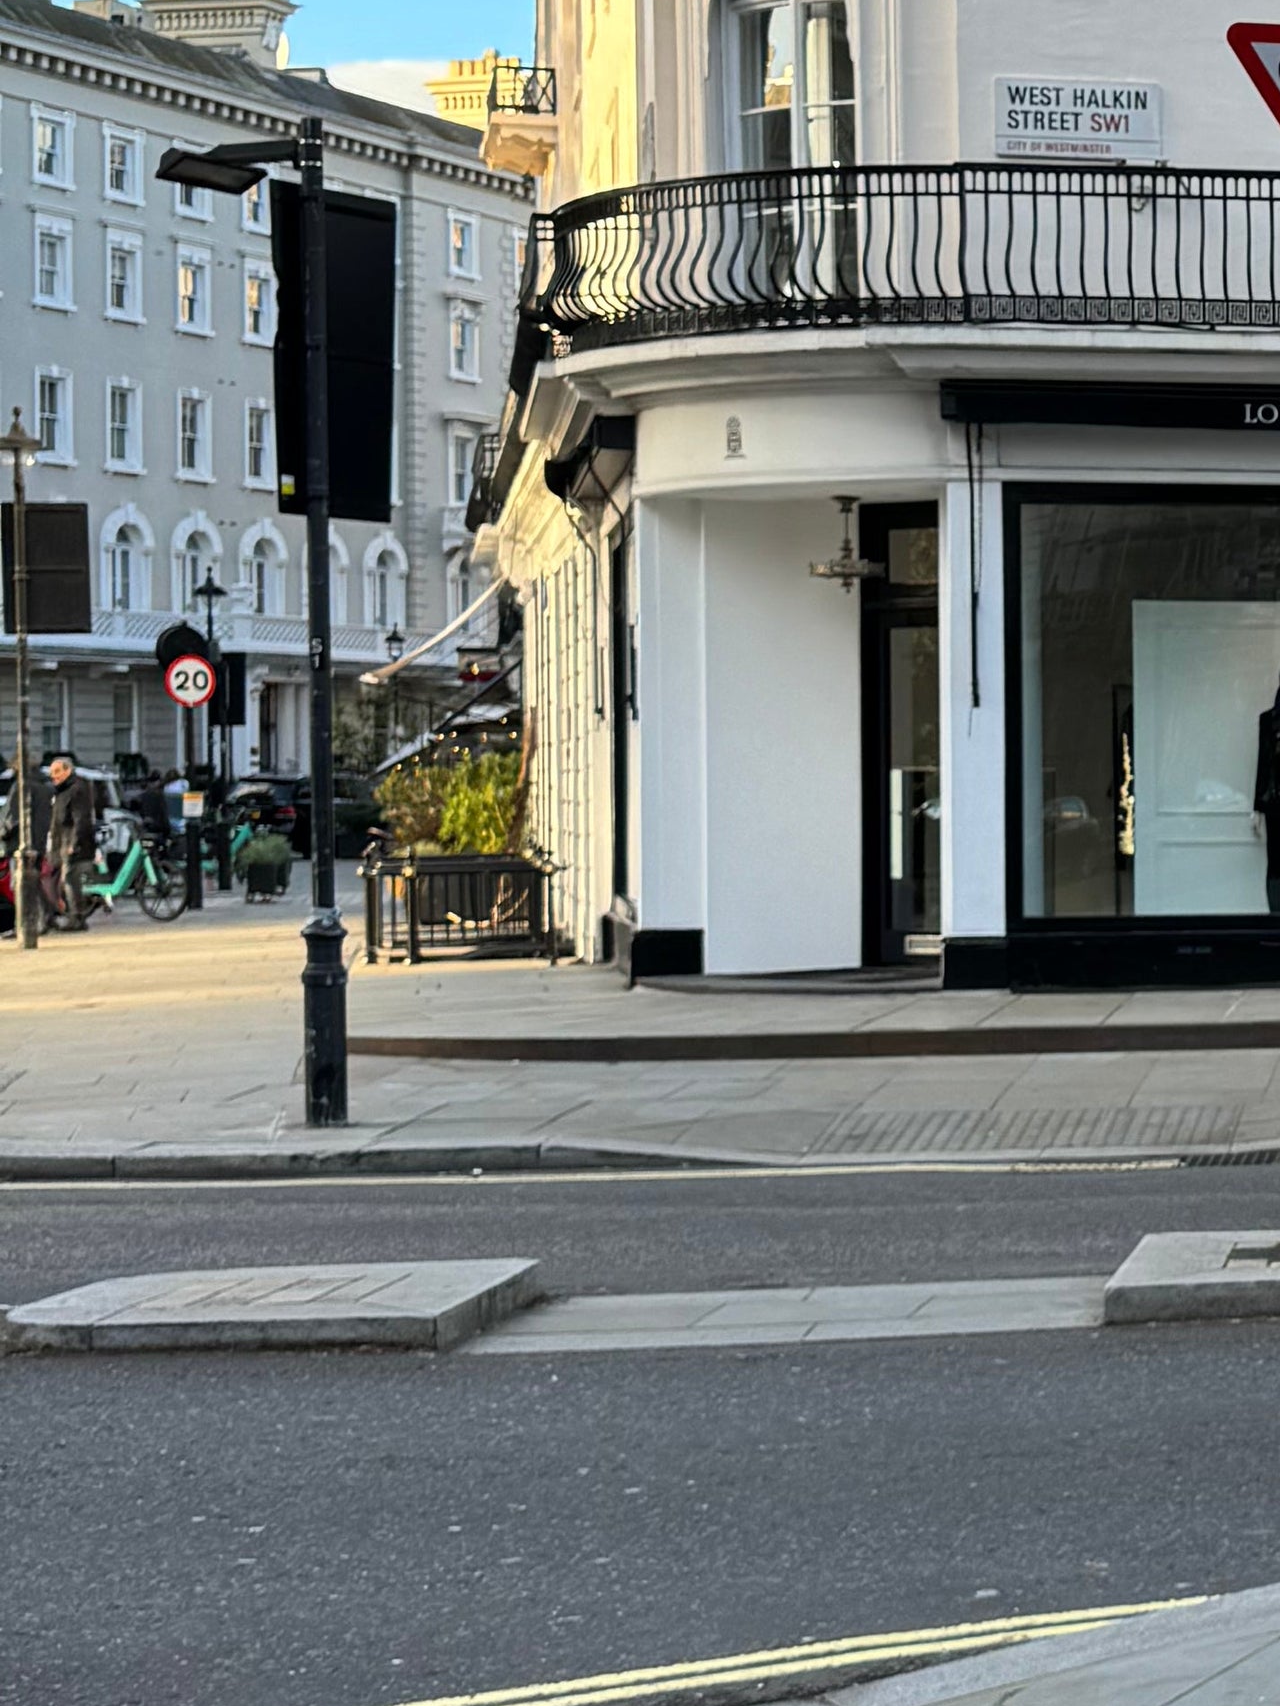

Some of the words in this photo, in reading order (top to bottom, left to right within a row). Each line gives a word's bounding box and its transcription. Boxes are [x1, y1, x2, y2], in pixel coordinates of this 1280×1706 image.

[1007, 86, 1065, 106] WEST
[1073, 88, 1148, 110] HALKIN
[1007, 110, 1083, 132] STREET
[1090, 113, 1130, 133] SW1
[1007, 140, 1027, 151] CITY
[1030, 141, 1042, 152] OF
[1044, 142, 1111, 154] WESTMINSTER
[174, 669, 209, 691] 20
